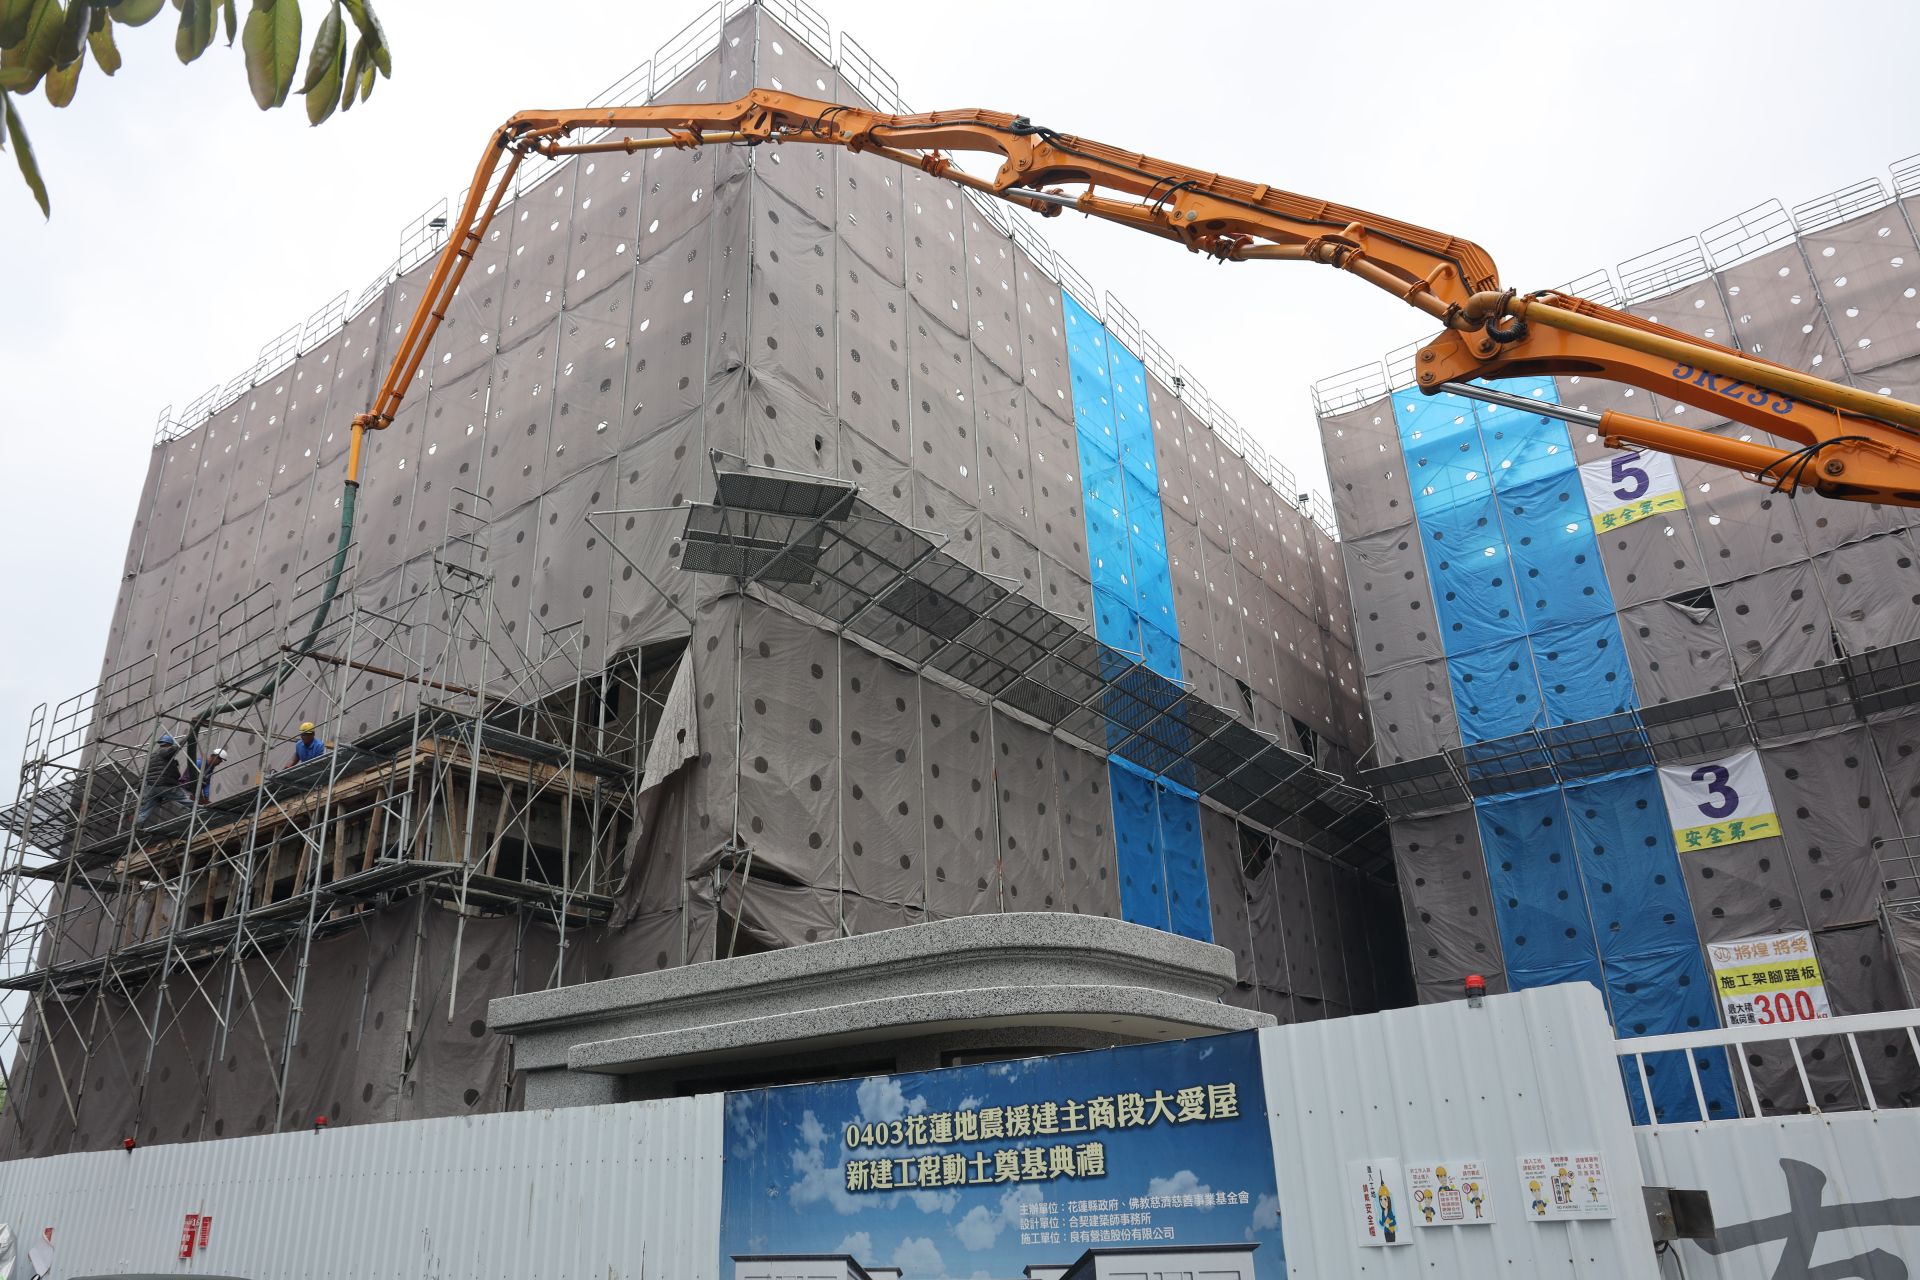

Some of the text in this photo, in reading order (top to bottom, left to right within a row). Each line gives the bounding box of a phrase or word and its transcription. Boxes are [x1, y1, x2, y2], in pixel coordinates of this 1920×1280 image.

[1611, 451, 1650, 501] 5
[1602, 499, 1676, 529] 安全第一
[1691, 764, 1739, 818] 3
[1685, 821, 1769, 848] 安全第一
[1720, 966, 1817, 989] 施工架腳踏板
[1754, 990, 1815, 1025] 300
[846, 1082, 1240, 1148] 0403花蓮地震援建主商段大愛屋
[846, 1141, 1106, 1191] 新建工程動土奠基典禮
